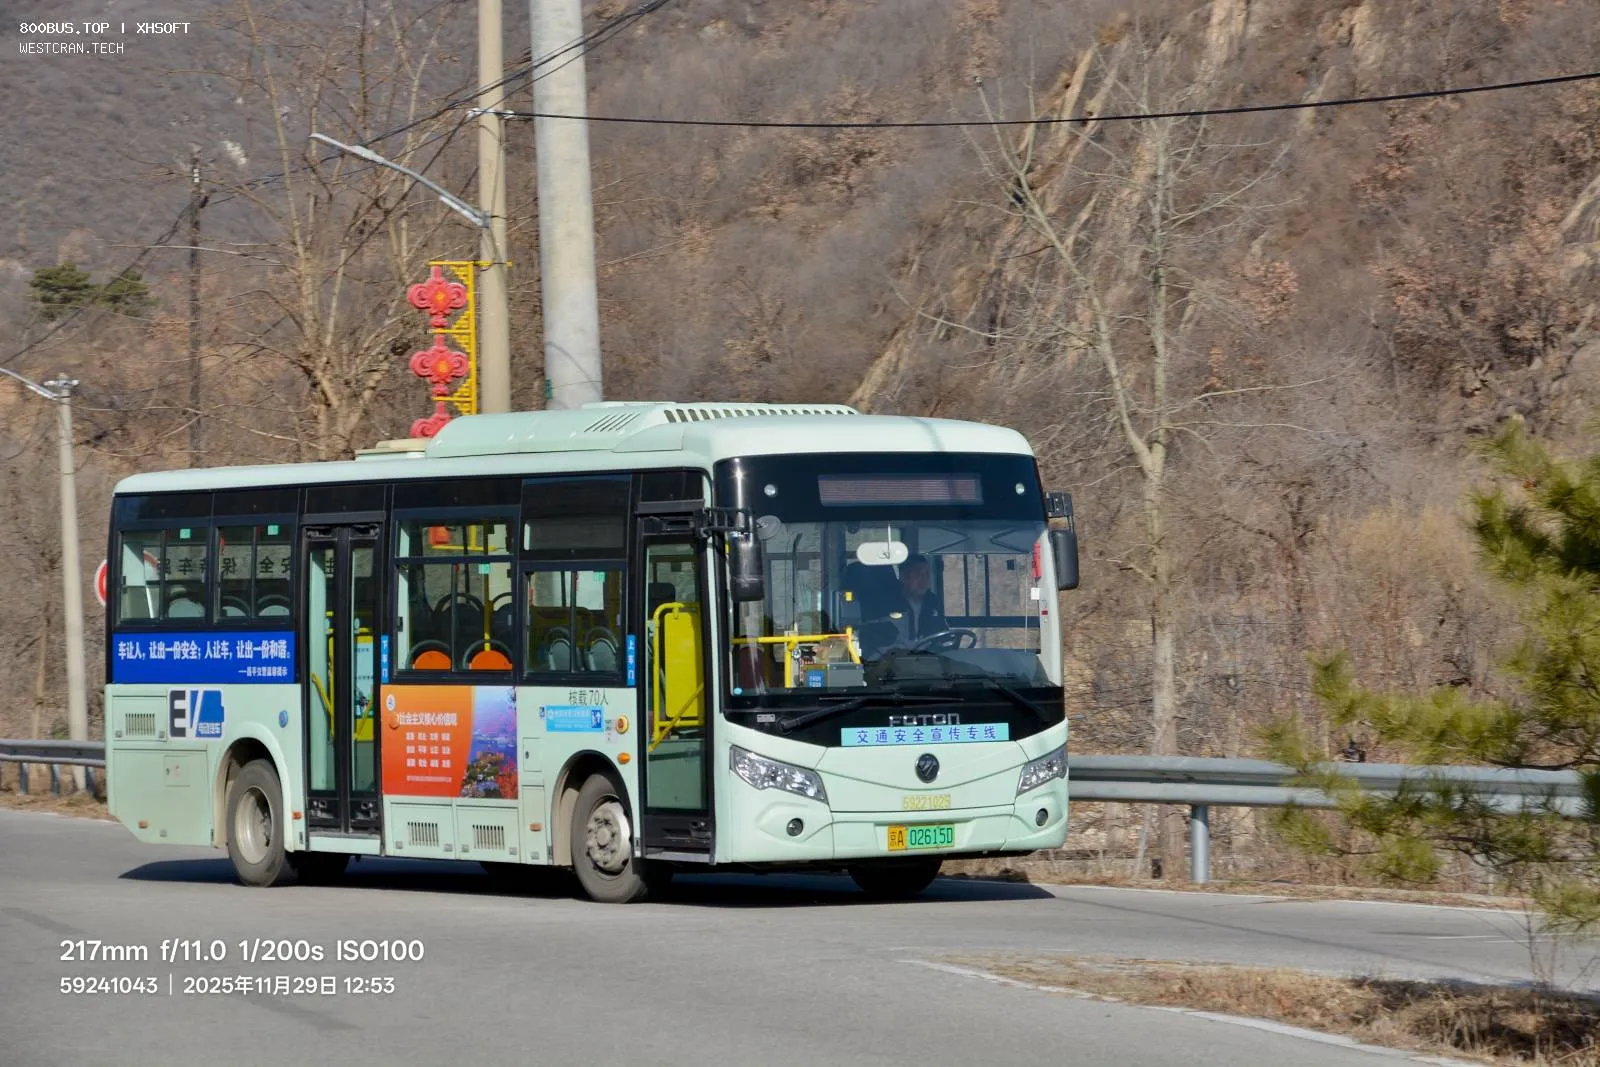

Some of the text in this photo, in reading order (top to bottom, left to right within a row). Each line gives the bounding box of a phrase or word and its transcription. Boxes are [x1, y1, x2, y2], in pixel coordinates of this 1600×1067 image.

[856, 725, 997, 744] 交通安全宣传专线
[909, 827, 953, 846] 02615D
